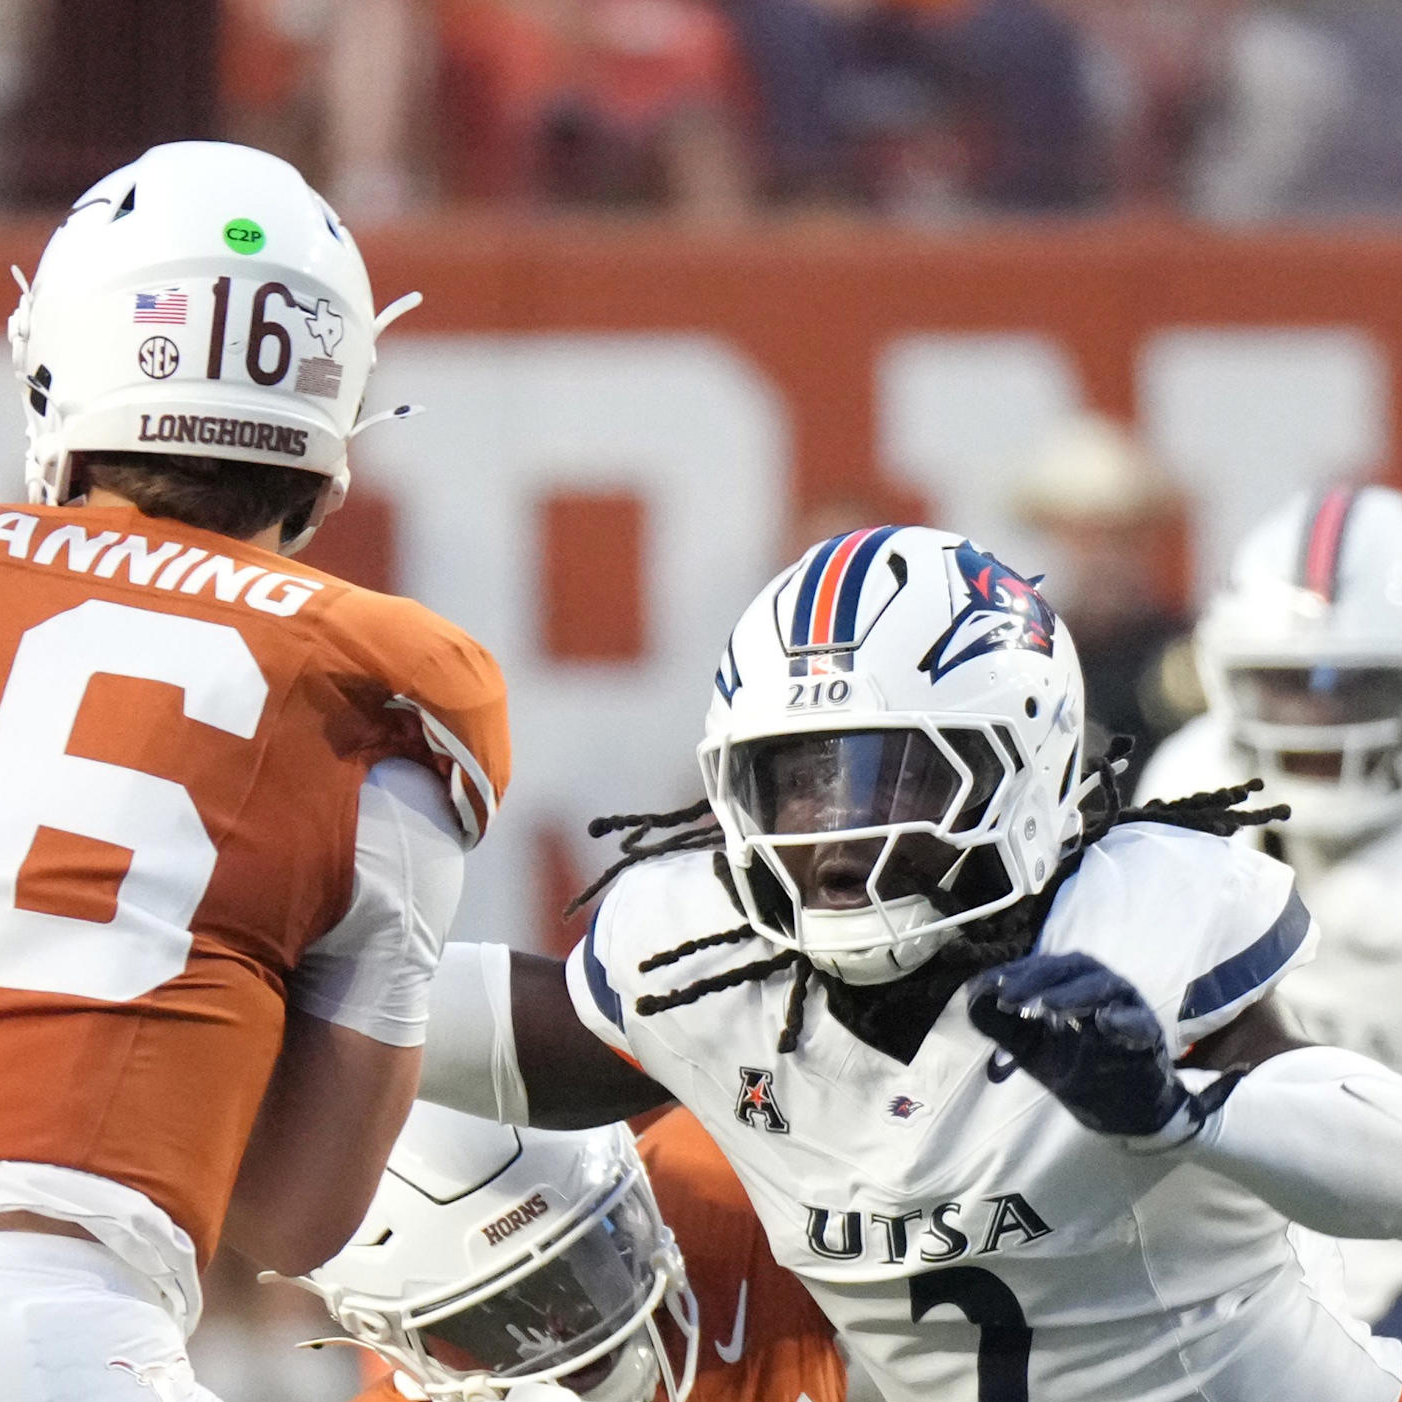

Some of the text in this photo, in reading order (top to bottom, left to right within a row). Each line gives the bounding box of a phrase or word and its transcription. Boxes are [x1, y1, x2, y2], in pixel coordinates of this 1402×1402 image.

[227, 228, 262, 243] C2P
[206, 276, 295, 386] 16
[139, 336, 179, 379] SEC
[138, 414, 309, 457] LONGHORNS
[785, 679, 852, 709] 210
[481, 1191, 549, 1247] HORNS
[805, 1191, 1054, 1265] UTSA
